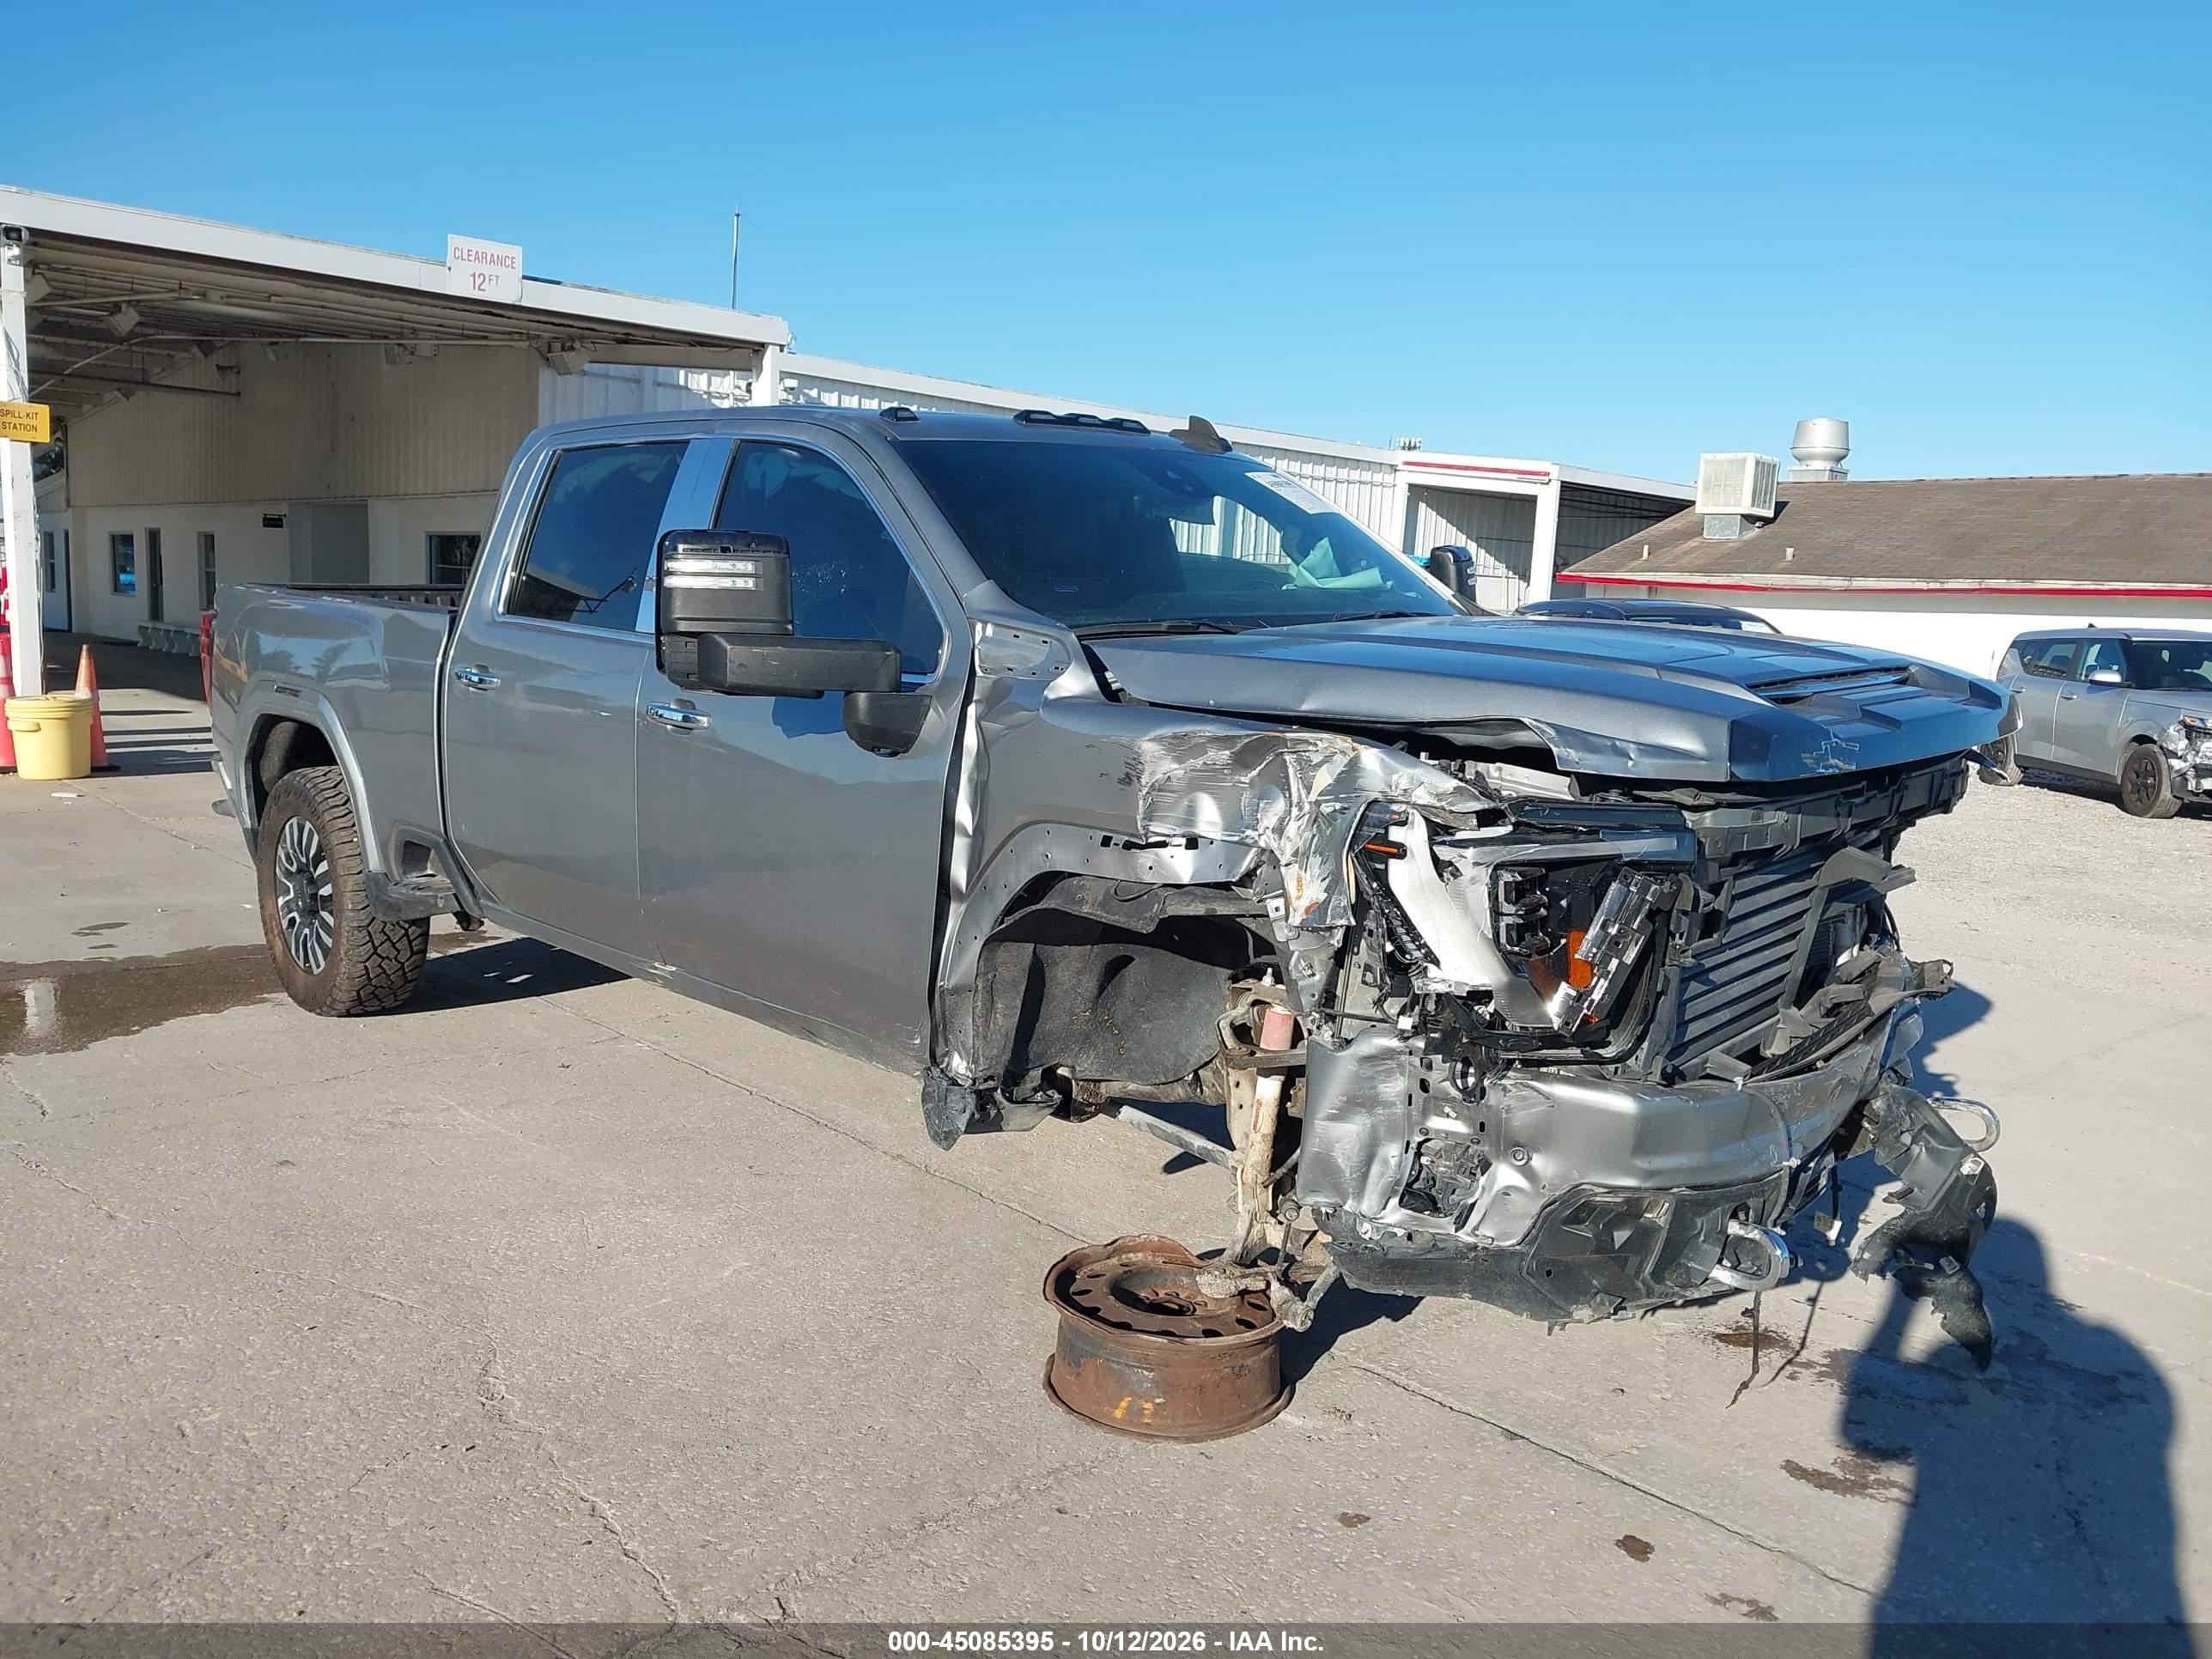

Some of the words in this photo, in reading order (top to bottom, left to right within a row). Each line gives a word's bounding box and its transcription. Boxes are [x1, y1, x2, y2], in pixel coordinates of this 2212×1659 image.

[453, 246, 517, 270] CLEARANCE
[470, 271, 487, 292] 12
[488, 274, 500, 287] FT
[0, 408, 40, 421] SPILL-KIT
[1, 421, 38, 433] STATION
